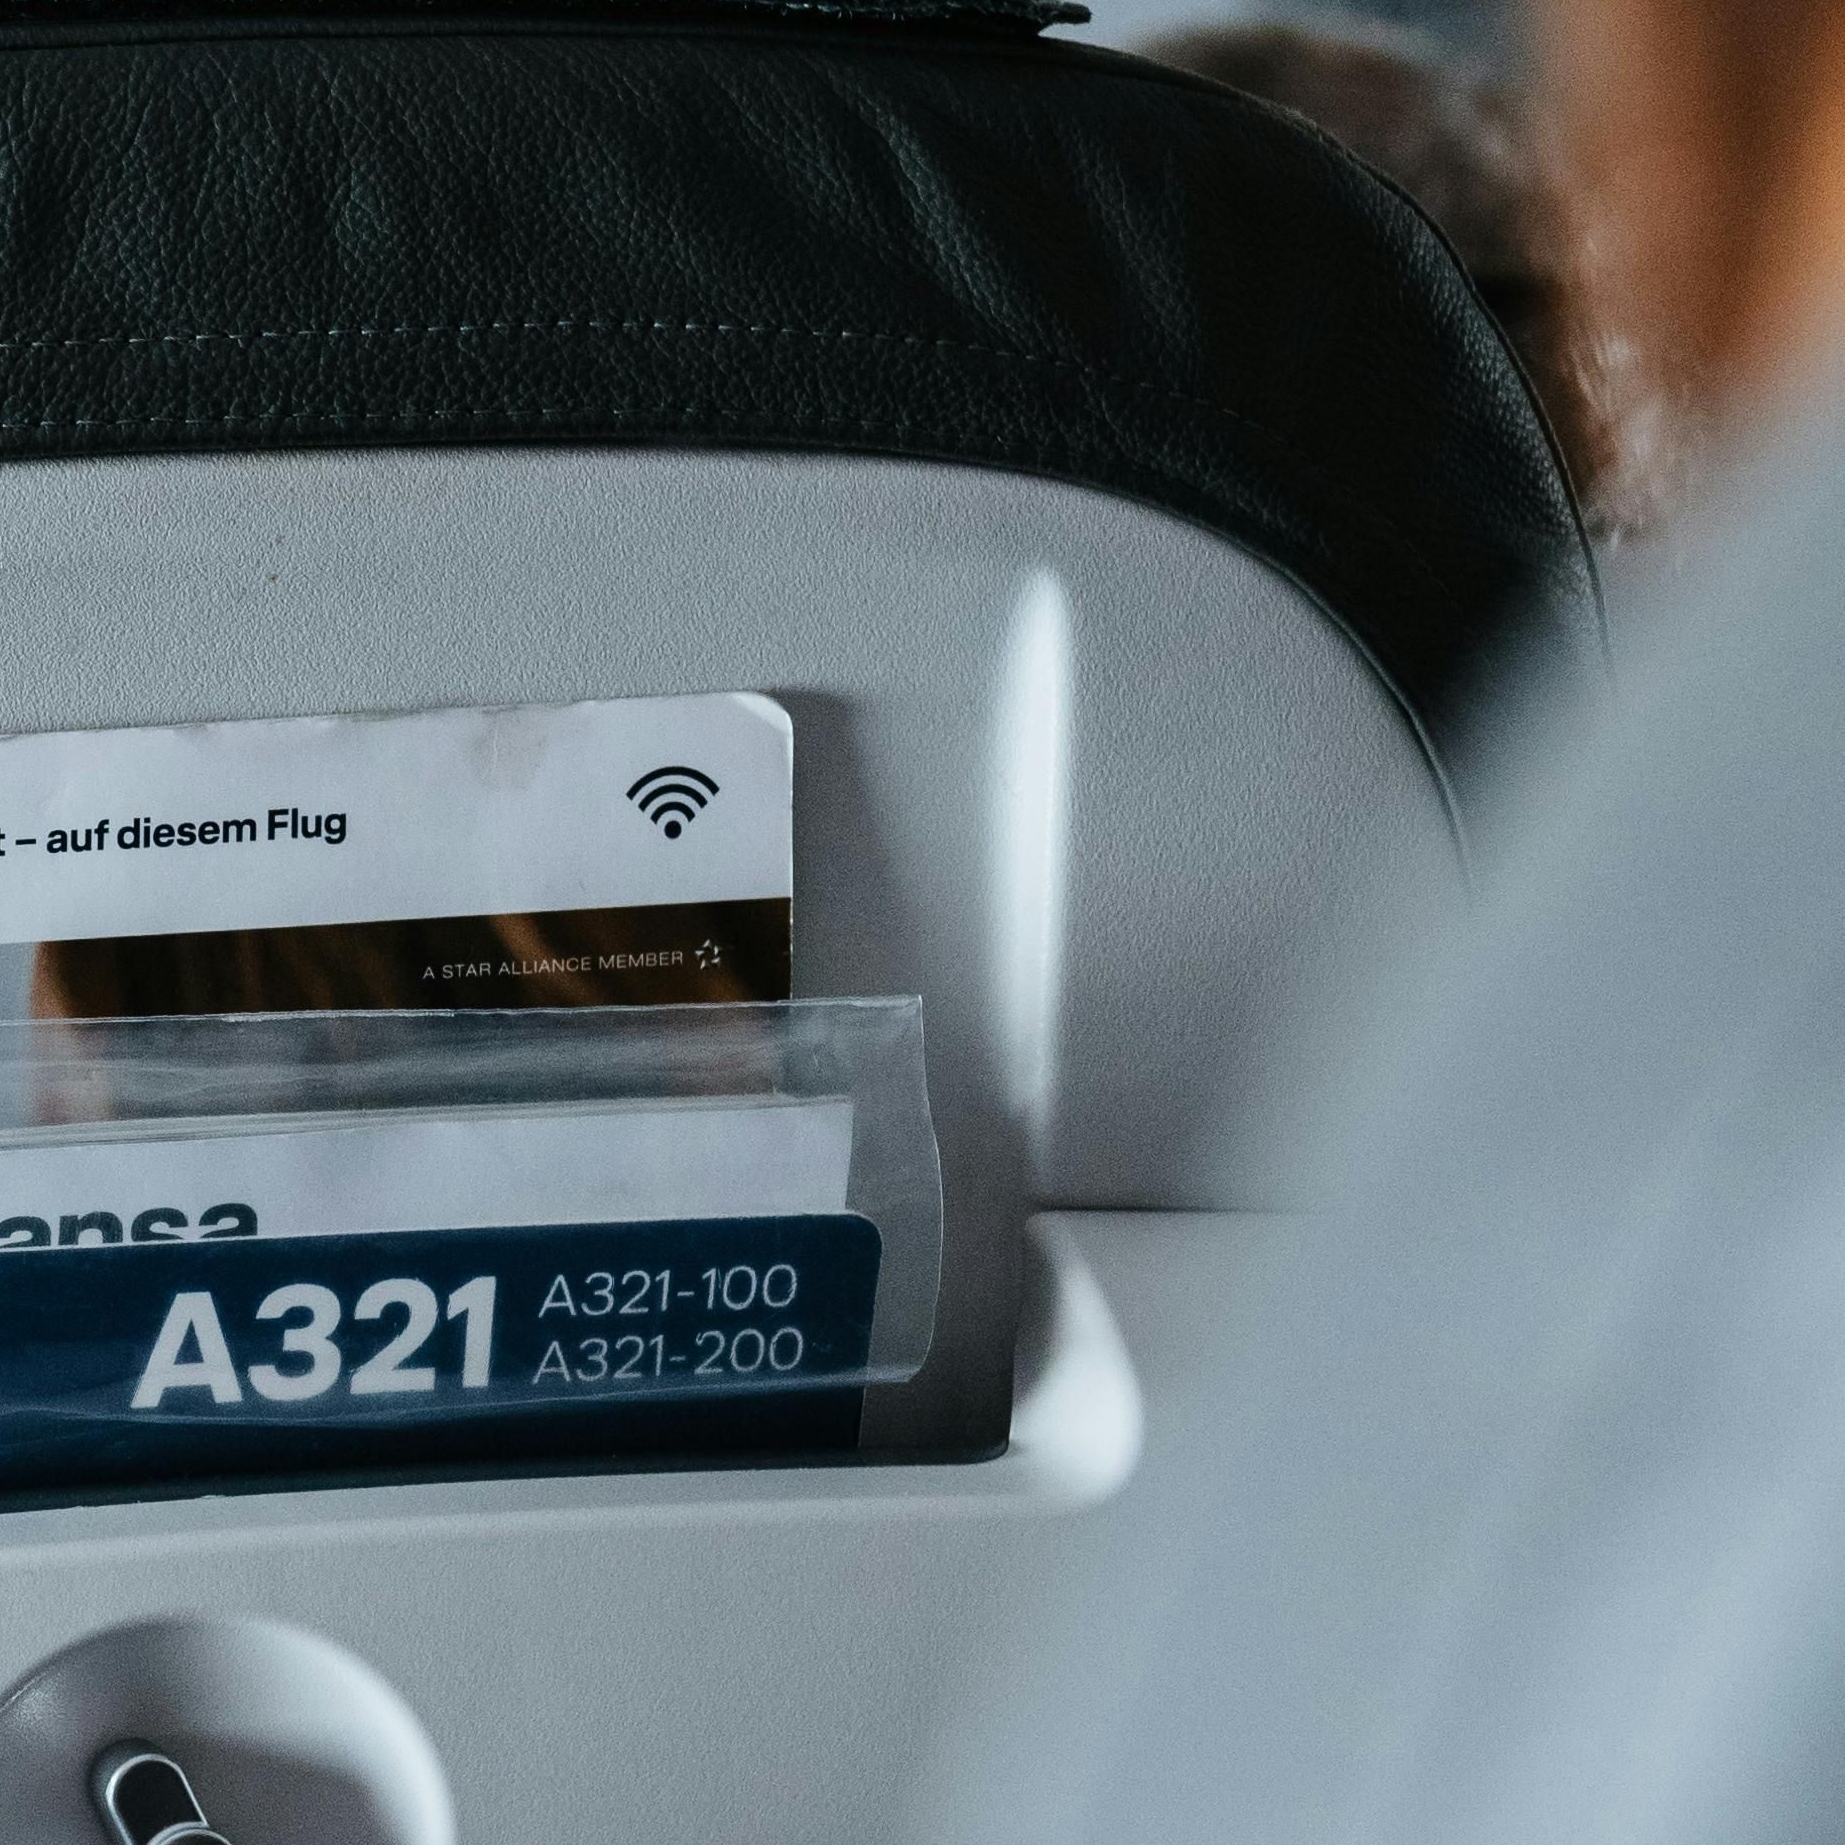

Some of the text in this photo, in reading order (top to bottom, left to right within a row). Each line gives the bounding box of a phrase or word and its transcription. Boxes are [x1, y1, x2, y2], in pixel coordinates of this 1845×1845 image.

[46, 819, 110, 854] auf
[116, 815, 257, 850] diesem
[267, 807, 348, 844] Flug
[422, 950, 684, 980] A STAR ALLIANCE MEMBER
[538, 1263, 798, 1319] A321-100
[129, 1275, 497, 1409] A321
[532, 1326, 804, 1385] A321-200
